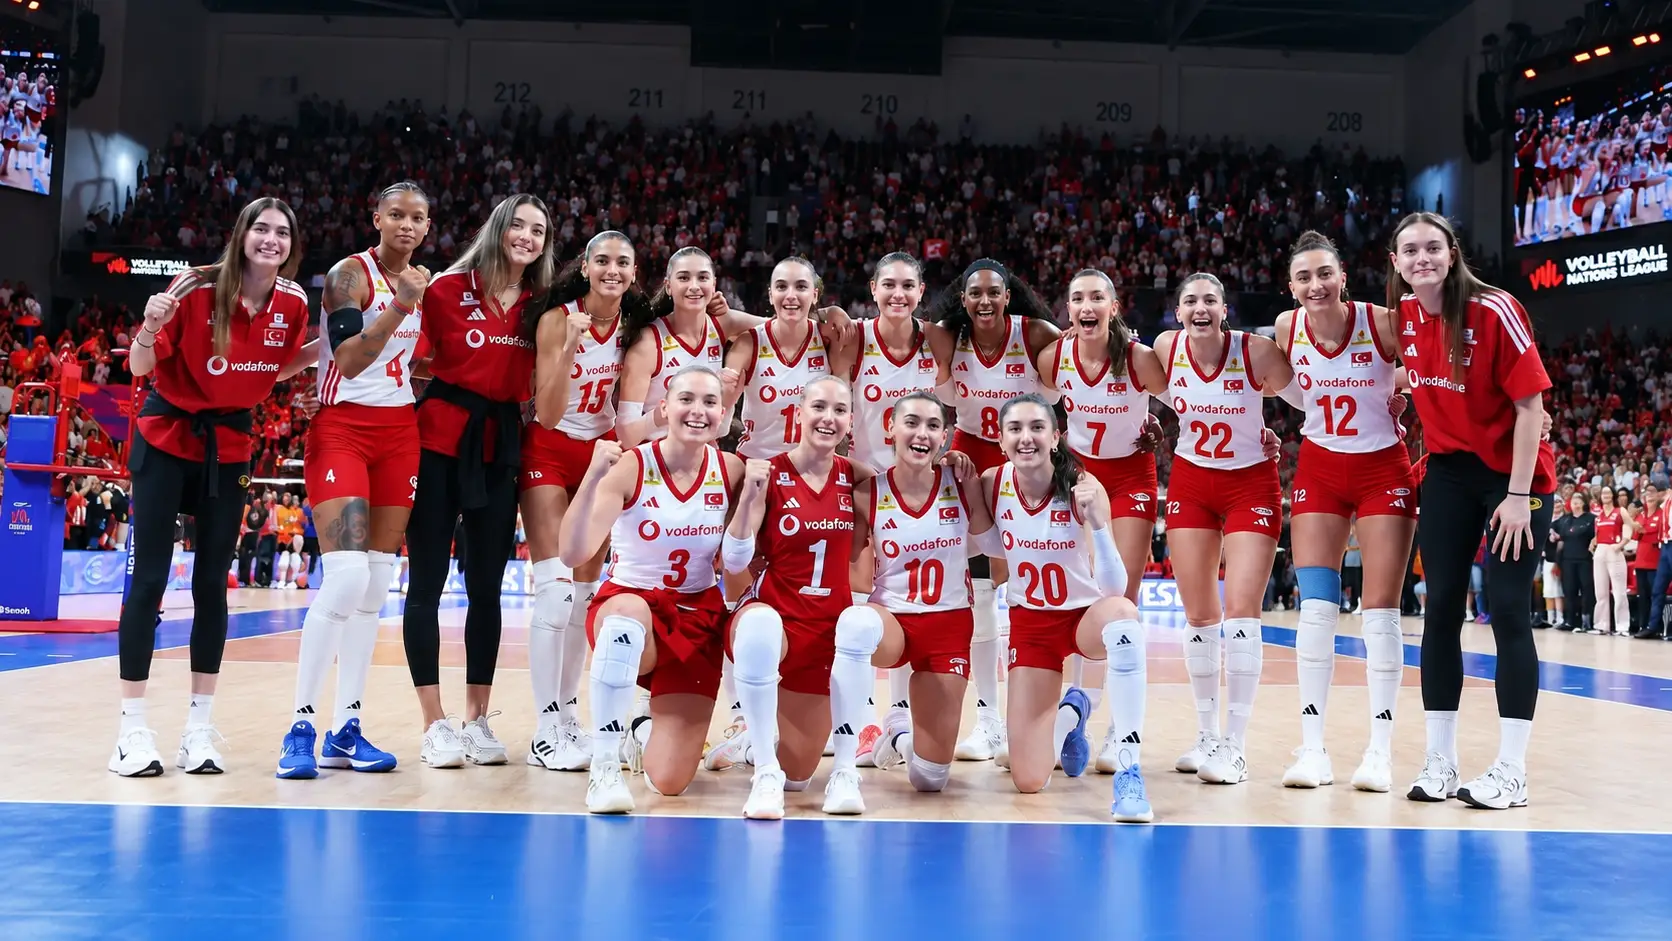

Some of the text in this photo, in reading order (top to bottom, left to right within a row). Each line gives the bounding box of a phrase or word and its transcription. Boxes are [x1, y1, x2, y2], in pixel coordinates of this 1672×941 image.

[494, 82, 531, 103] 212
[629, 88, 664, 108] 211
[733, 90, 766, 110] 211
[861, 94, 898, 114] 210
[1096, 102, 1131, 122] 209
[1326, 112, 1362, 132] 208
[1565, 244, 1667, 273] VOLLEYBALL
[1566, 259, 1668, 285] NATIONS LEAGUE
[231, 361, 279, 372] vodafone
[386, 349, 405, 388] 4
[1316, 377, 1375, 388] vodafone
[1419, 376, 1466, 392] vodafone
[576, 378, 614, 414] 15
[1077, 405, 1129, 415] vodafone
[1190, 403, 1246, 415] vodafone
[1316, 394, 1359, 436] 12
[981, 406, 1000, 439] 8
[1086, 421, 1107, 456] 7
[1190, 420, 1235, 459] 22
[325, 469, 336, 483] 4
[1293, 489, 1306, 502] 12
[665, 524, 724, 537] vodafone
[804, 518, 854, 531] vodafone
[903, 536, 962, 553] vodafone
[1017, 538, 1076, 551] vodafone
[662, 548, 690, 588] 3
[799, 539, 832, 597] 1
[904, 558, 945, 606] 10
[1017, 561, 1068, 607] 20
